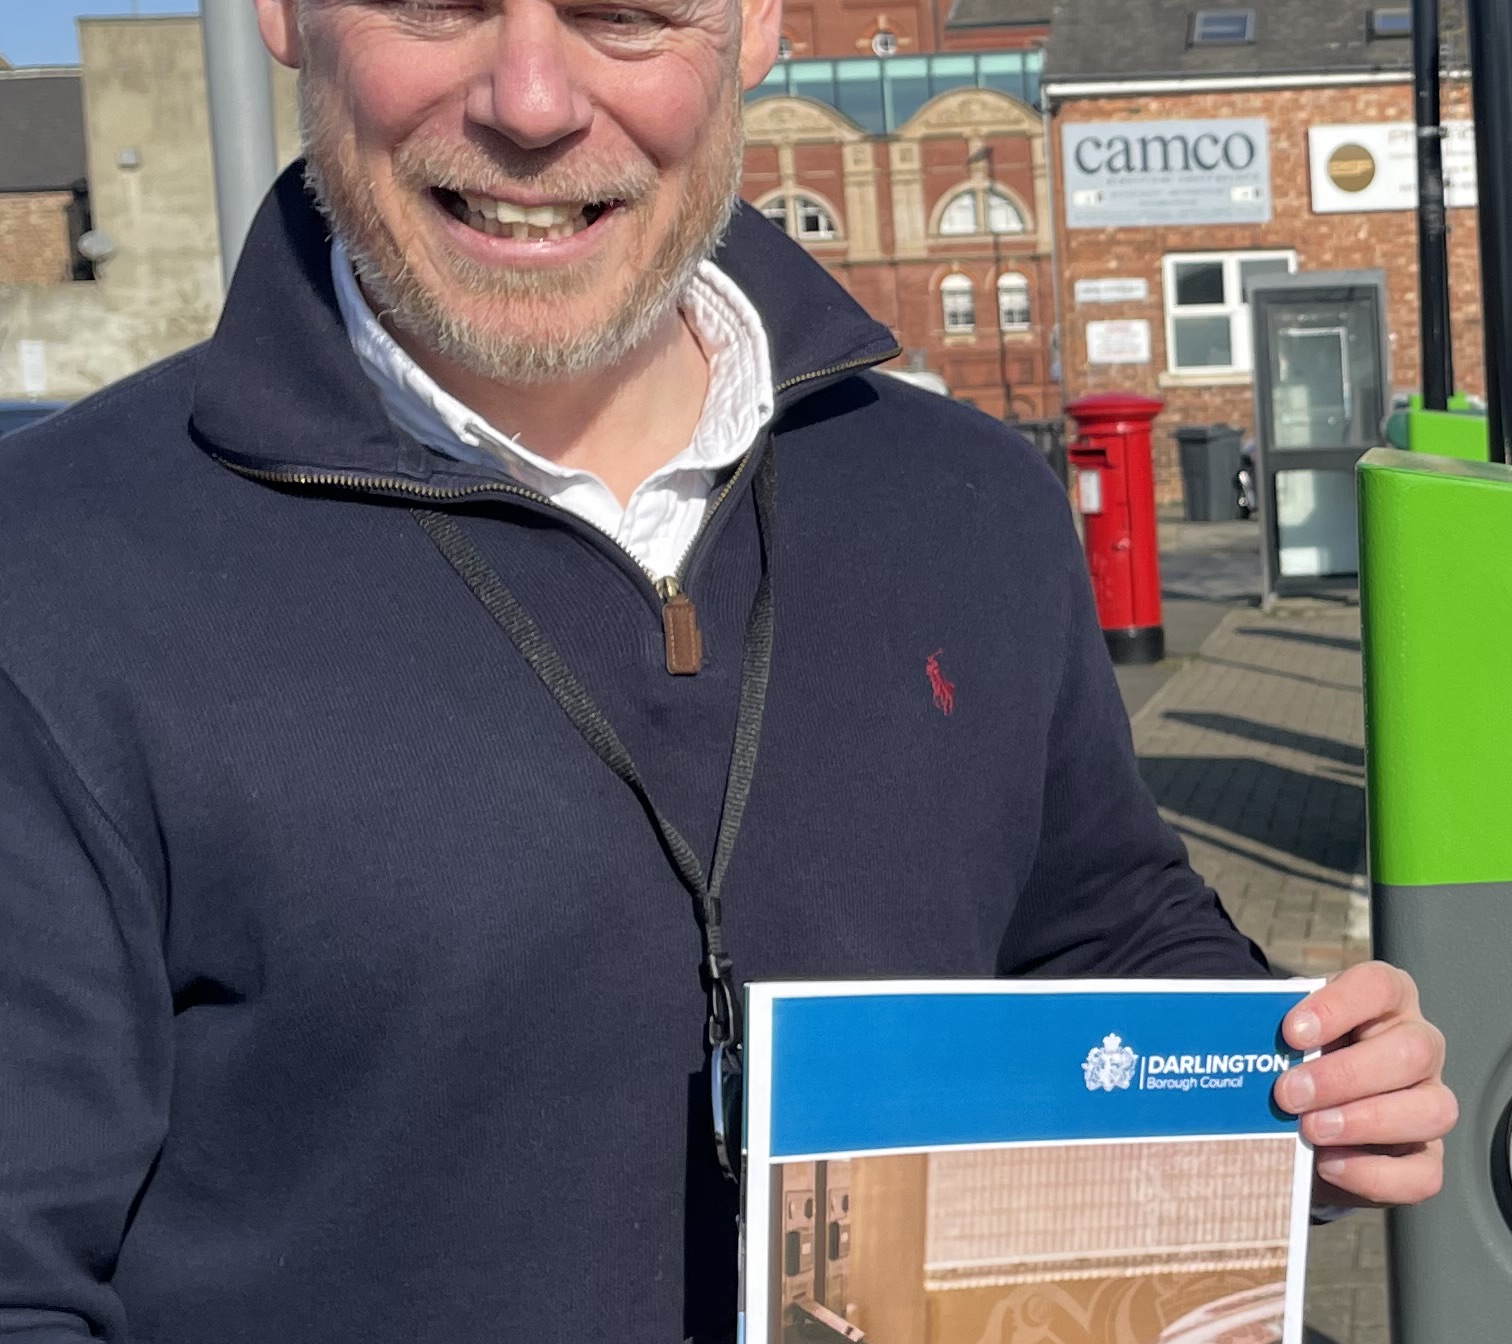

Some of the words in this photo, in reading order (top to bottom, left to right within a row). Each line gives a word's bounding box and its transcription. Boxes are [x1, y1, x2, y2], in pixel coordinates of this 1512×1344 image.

[1074, 131, 1257, 175] camco
[1147, 1053, 1290, 1075] DARLINGTON
[1146, 1075, 1197, 1092] Borough
[1199, 1074, 1244, 1089] Council
